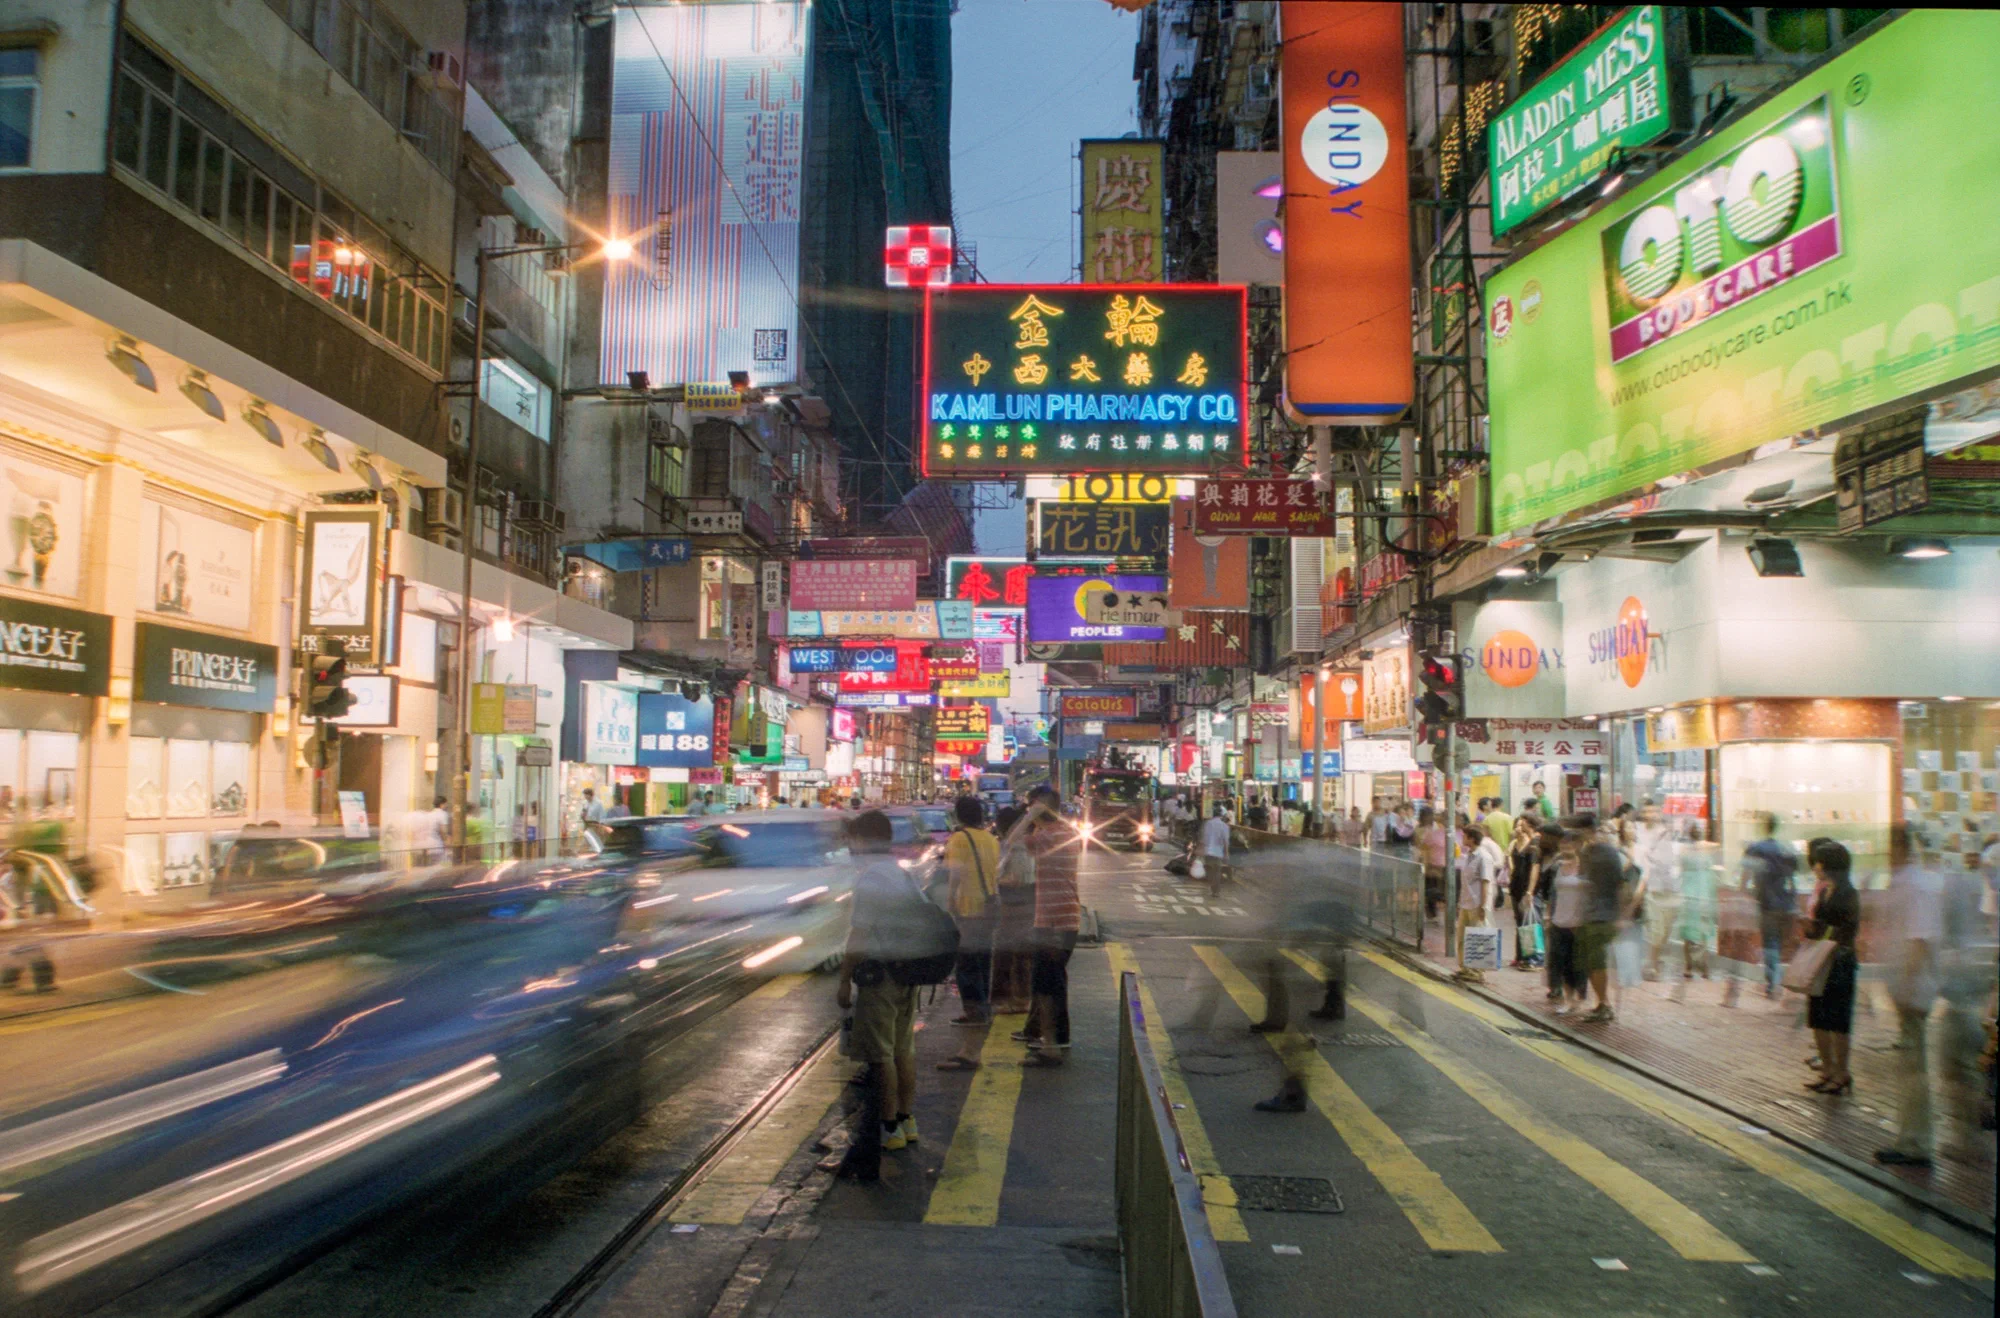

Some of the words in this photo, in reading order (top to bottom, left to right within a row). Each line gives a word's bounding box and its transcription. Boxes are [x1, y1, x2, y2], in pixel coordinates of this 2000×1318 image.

[1495, 80, 1577, 168] ALADIN
[1583, 6, 1655, 104] MESS
[1327, 69, 1363, 220] SUNDAY
[1620, 136, 1805, 301] OTO
[1638, 243, 1795, 342] BODYCARE
[1009, 294, 1164, 347] 金輪
[1612, 281, 1853, 407] www.otobodycare.com.hk
[962, 351, 1209, 388] 中西大藥房
[931, 394, 1041, 420] KAMLUN
[1046, 394, 1192, 420] PHARMACY
[1044, 506, 1142, 552] 花訊
[1070, 626, 1123, 637] PEOPLES
[1588, 618, 1649, 664] SUNDAY
[171, 648, 231, 681] PRINCE
[1462, 647, 1564, 669] SUNDAY
[1496, 740, 1601, 756] 攝影公司
